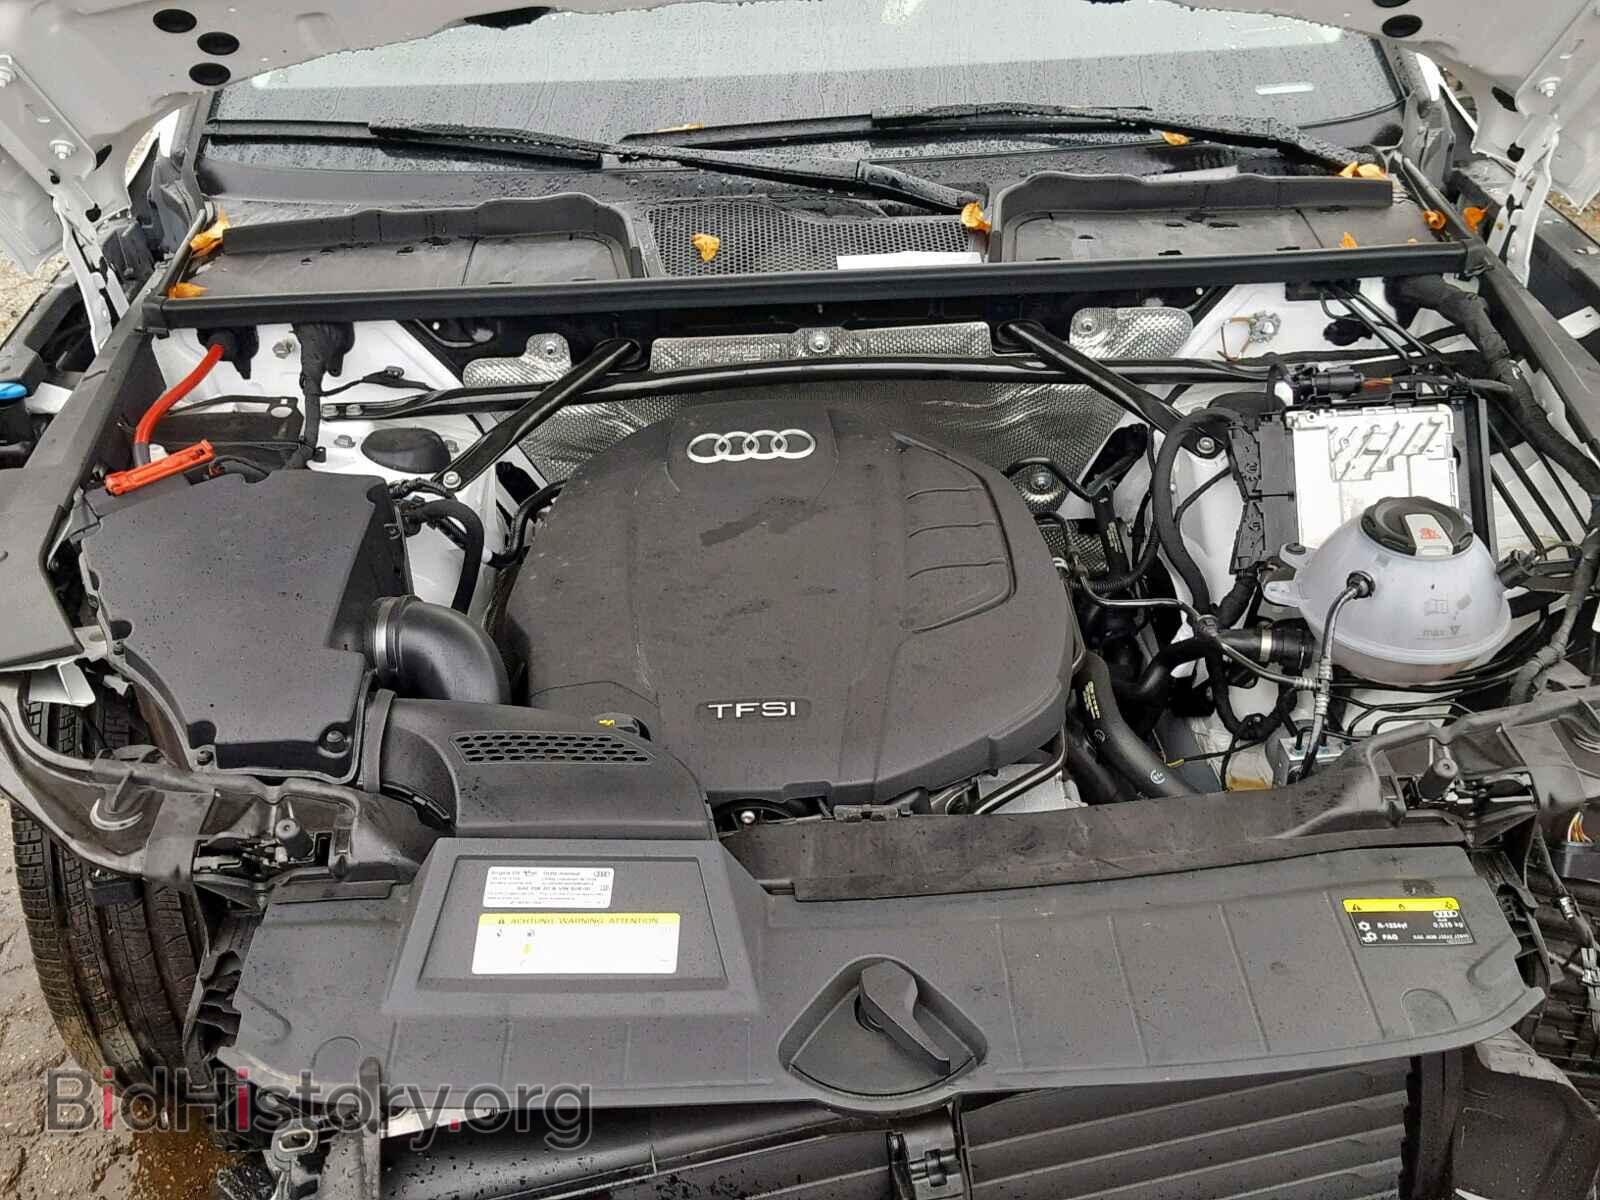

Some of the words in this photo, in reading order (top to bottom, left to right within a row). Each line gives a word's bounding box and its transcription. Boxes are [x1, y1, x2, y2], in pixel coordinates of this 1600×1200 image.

[1423, 629, 1446, 637] max
[708, 701, 795, 718] TFSI
[559, 917, 604, 925] WARNING
[608, 917, 658, 925] ATTENTION
